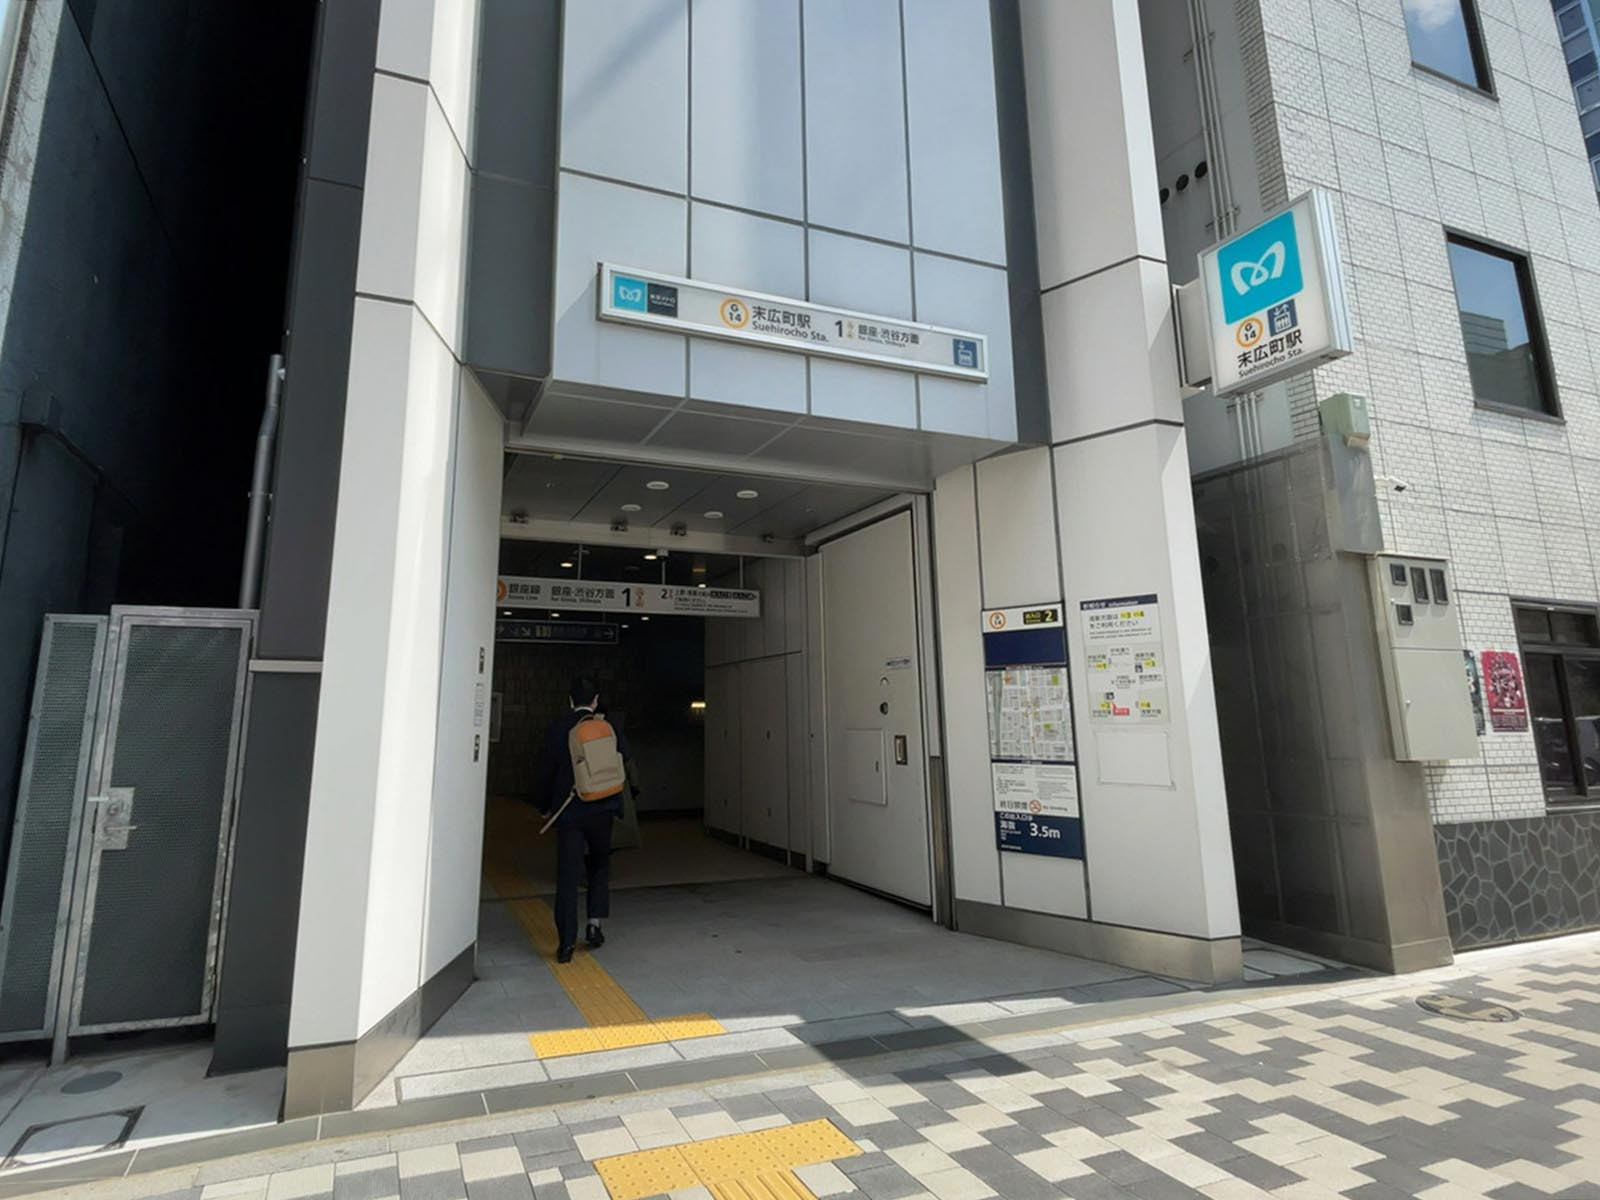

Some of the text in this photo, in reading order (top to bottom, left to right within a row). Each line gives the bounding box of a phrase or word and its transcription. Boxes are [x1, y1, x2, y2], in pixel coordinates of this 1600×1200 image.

[730, 303, 739, 312] G
[729, 311, 742, 322] 14
[752, 305, 811, 329] 末広町駅
[752, 321, 829, 341] Suehirocho Sta.
[835, 320, 843, 337] 1
[1244, 330, 1257, 341] 14
[1245, 322, 1253, 332] G
[1237, 329, 1303, 368] 末広町駅
[1238, 355, 1286, 377] Suehirocho
[621, 587, 631, 607] 1
[661, 588, 668, 599] 2
[1044, 610, 1053, 622] 2
[1029, 822, 1061, 839] 3.5m
